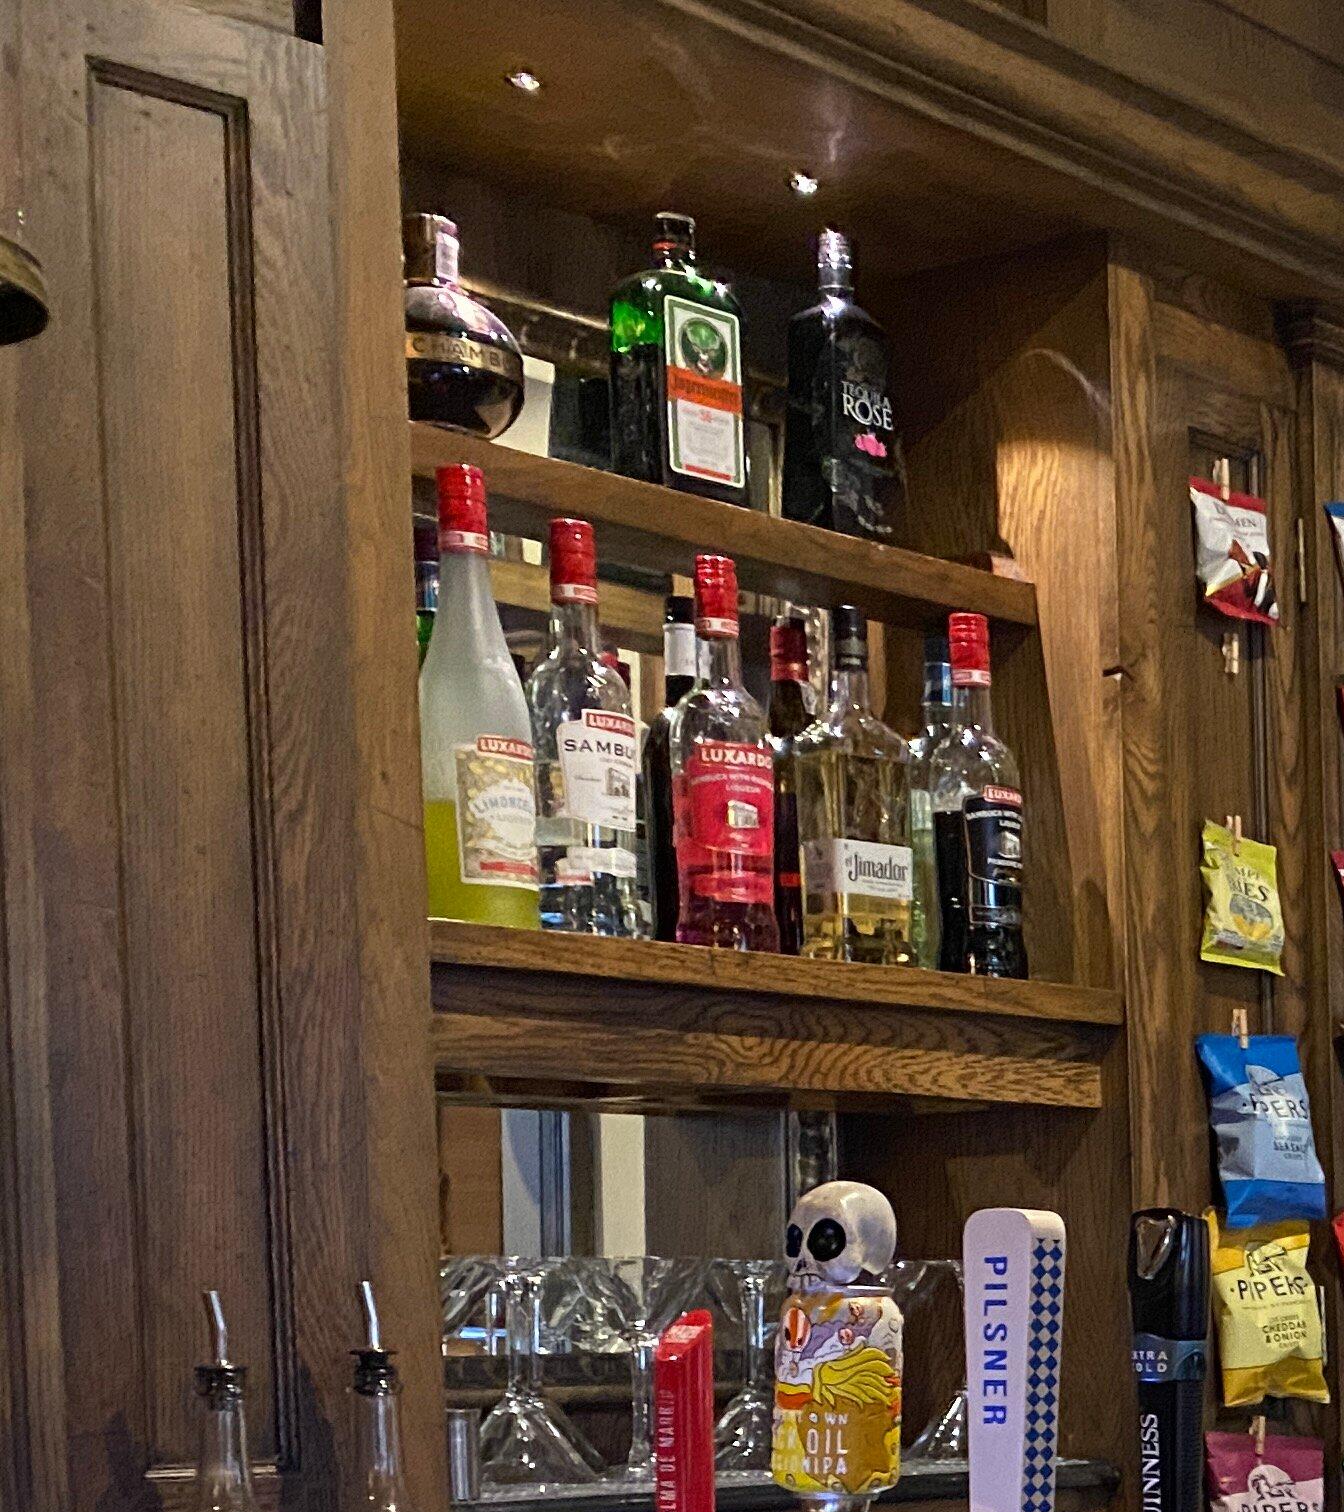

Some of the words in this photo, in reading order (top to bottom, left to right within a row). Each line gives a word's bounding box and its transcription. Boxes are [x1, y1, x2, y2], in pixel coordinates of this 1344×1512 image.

[411, 336, 512, 367] CHAMB
[844, 393, 893, 431] ROSE
[849, 853, 909, 882] Jimador
[983, 1256, 1008, 1425] PILSNER
[1132, 1362, 1168, 1373] OLD
[806, 1428, 849, 1455] OIL
